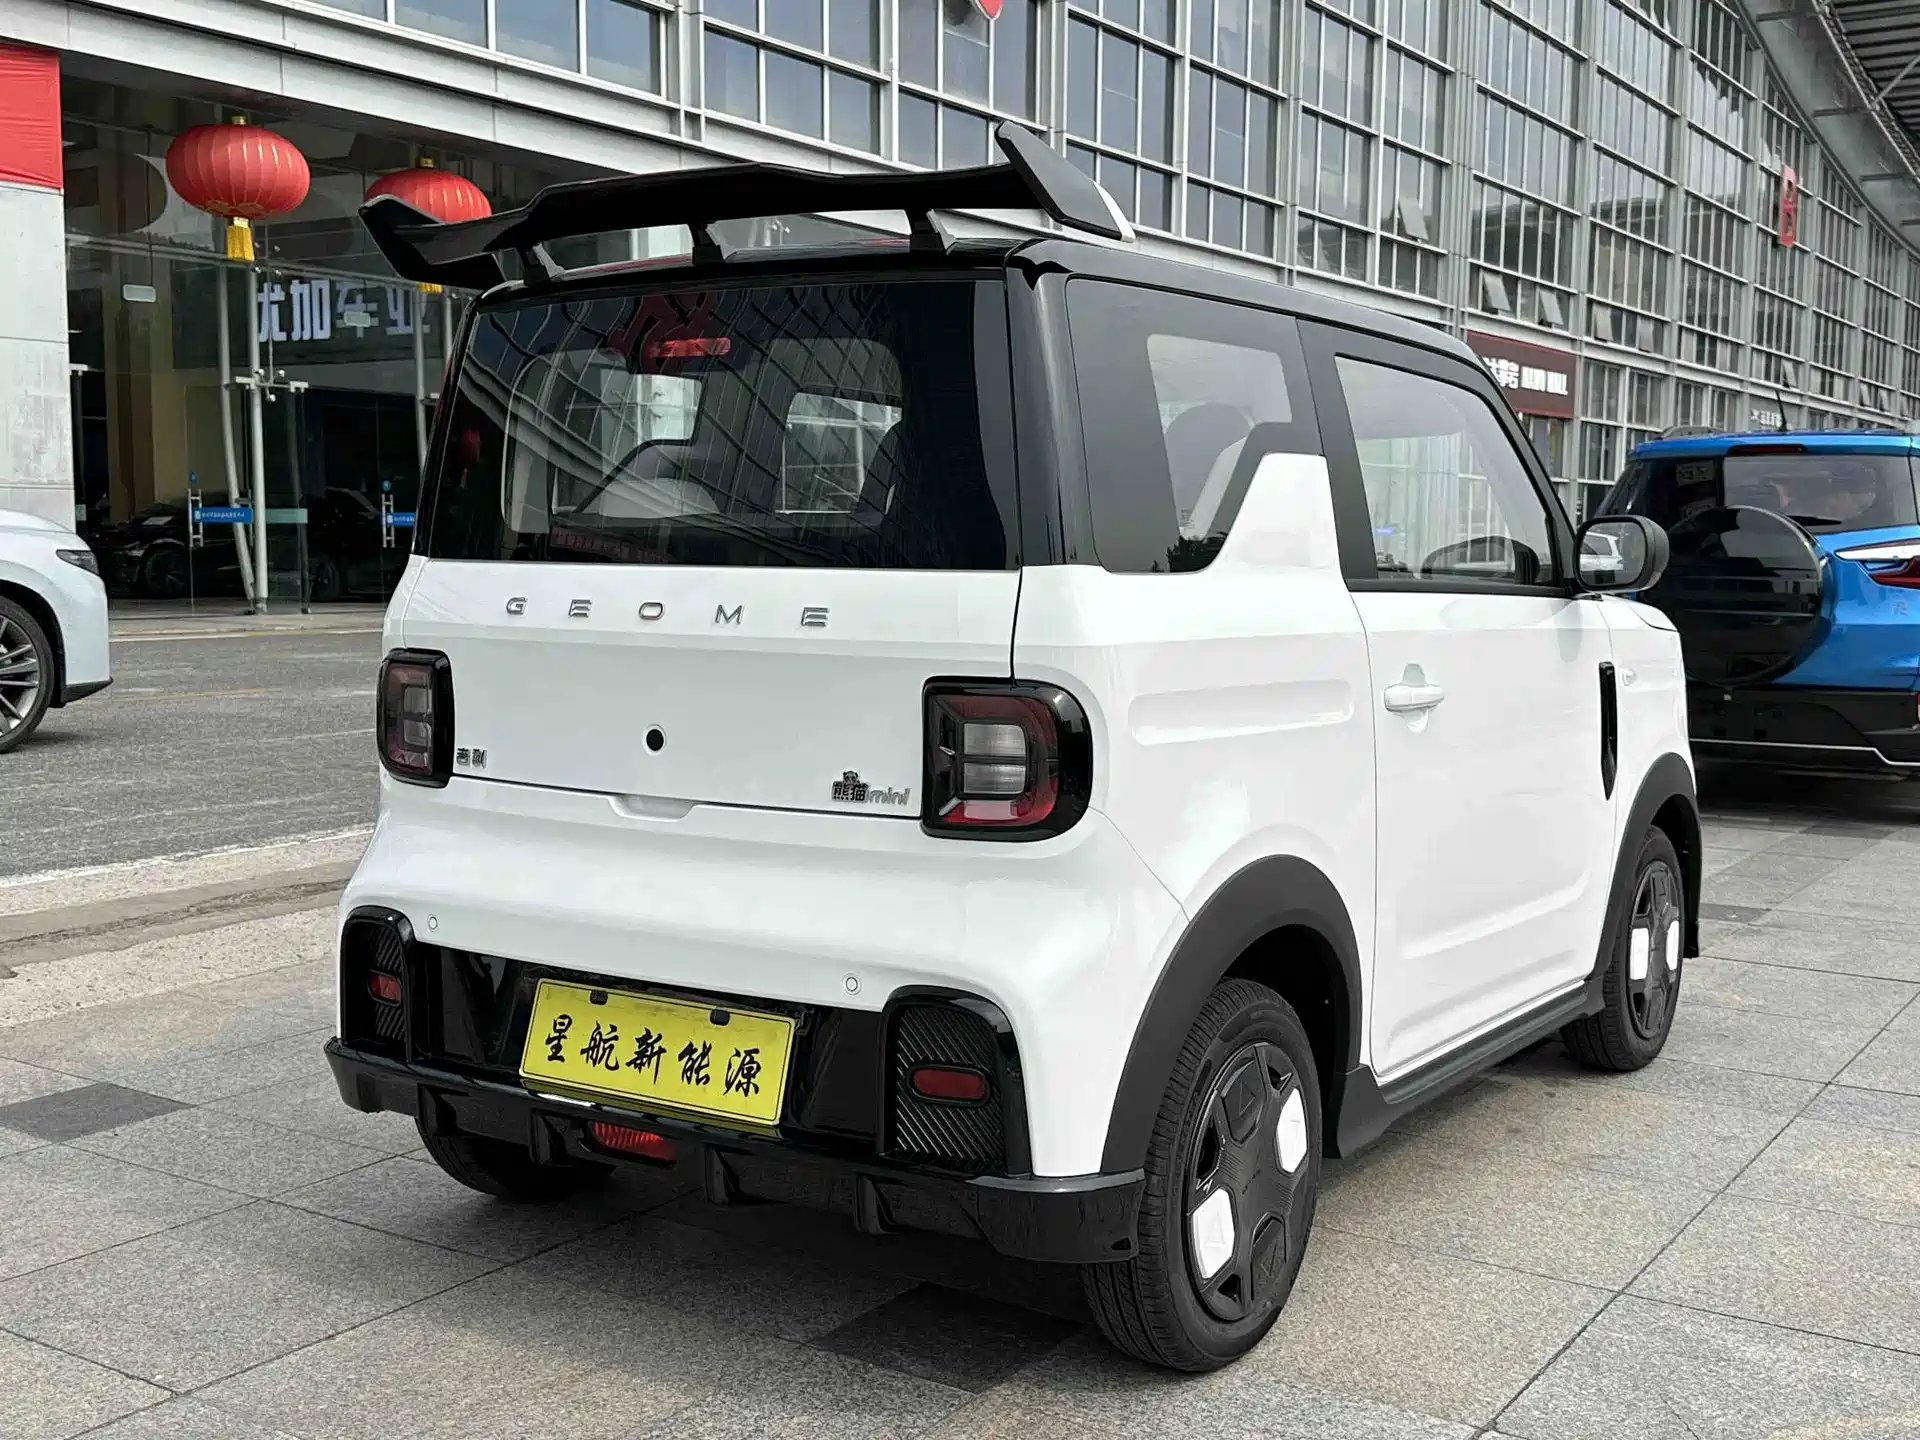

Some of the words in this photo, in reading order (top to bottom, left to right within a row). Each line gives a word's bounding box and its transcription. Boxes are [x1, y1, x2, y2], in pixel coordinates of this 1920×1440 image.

[505, 596, 831, 628] GEOME
[545, 1013, 763, 1098] 星航新能源
